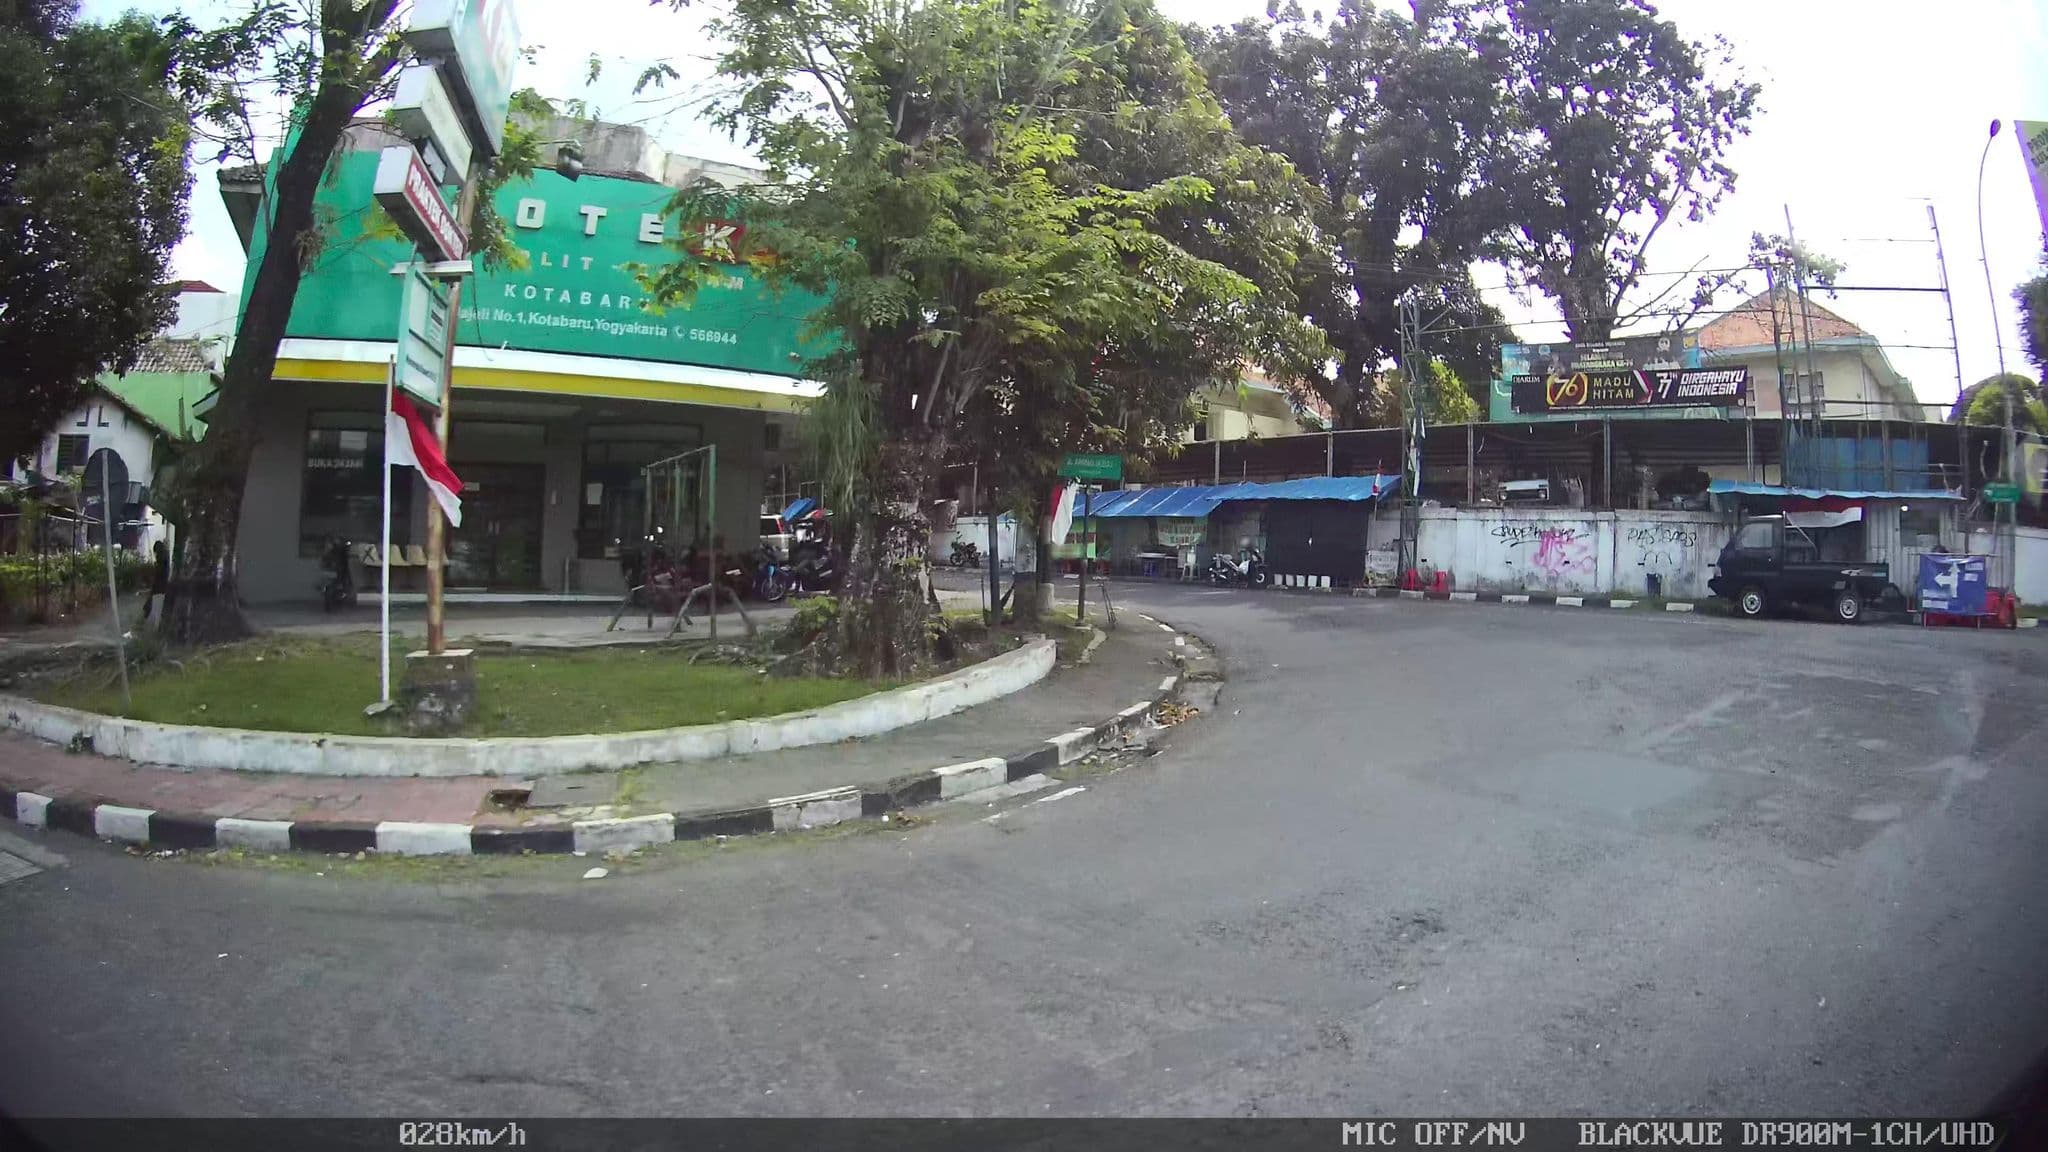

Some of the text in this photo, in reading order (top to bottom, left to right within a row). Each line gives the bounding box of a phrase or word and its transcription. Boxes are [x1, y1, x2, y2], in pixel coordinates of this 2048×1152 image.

[1593, 376, 1631, 387] MADU
[1680, 369, 1745, 385] DIRGAHAYU
[1554, 375, 1577, 400] 76
[1593, 388, 1634, 399] HITAM
[1677, 382, 1738, 397] INDONESIA
